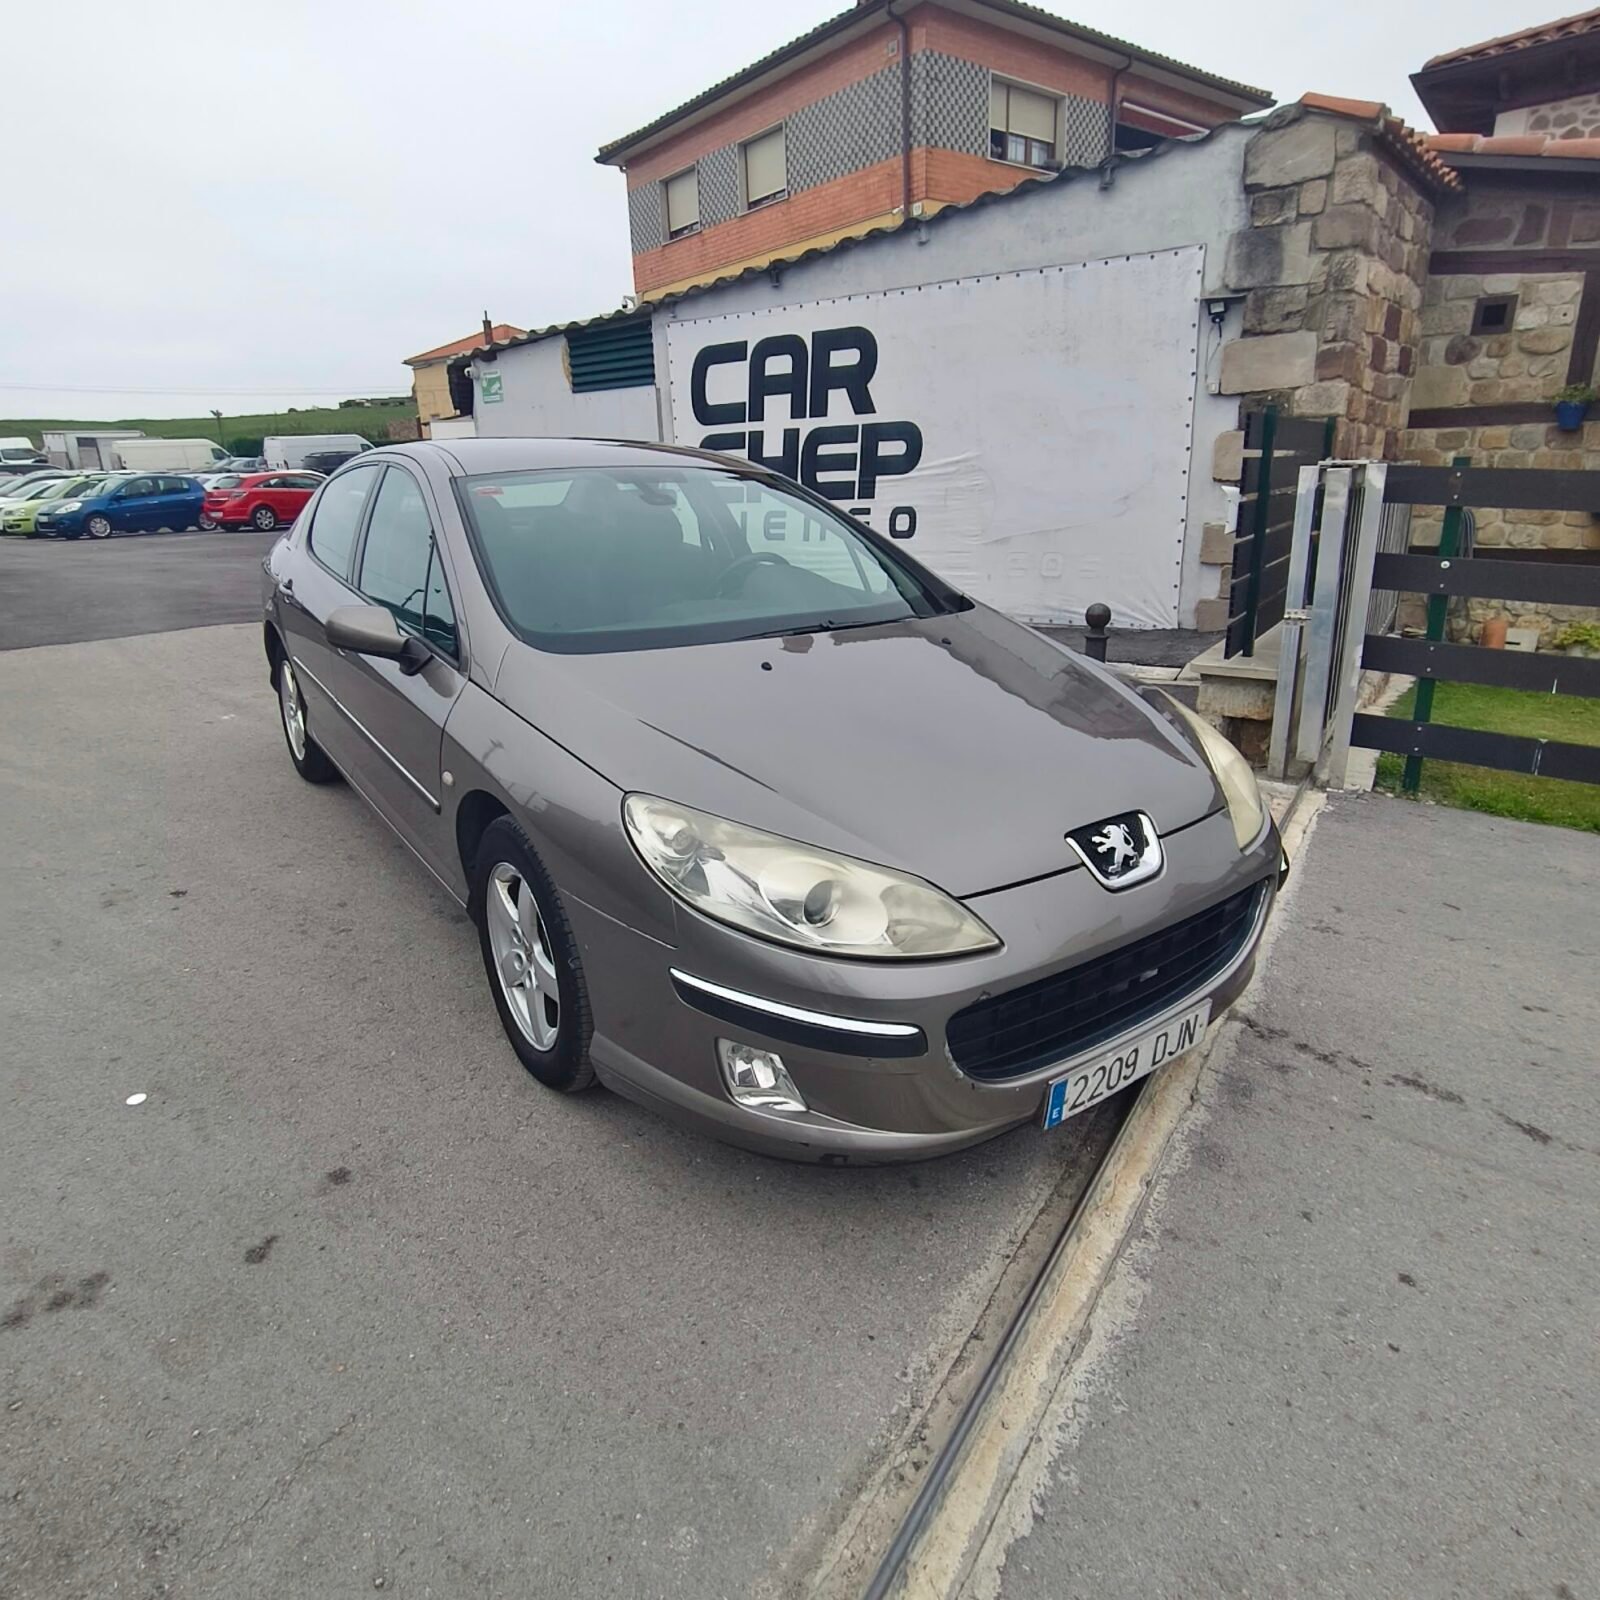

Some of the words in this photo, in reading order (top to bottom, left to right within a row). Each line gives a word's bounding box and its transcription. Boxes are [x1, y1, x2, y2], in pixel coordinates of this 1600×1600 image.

[691, 326, 878, 426] CAR
[699, 420, 924, 501] HEP
[1068, 1047, 1140, 1112] 2209
[1151, 1014, 1199, 1067] DJN
